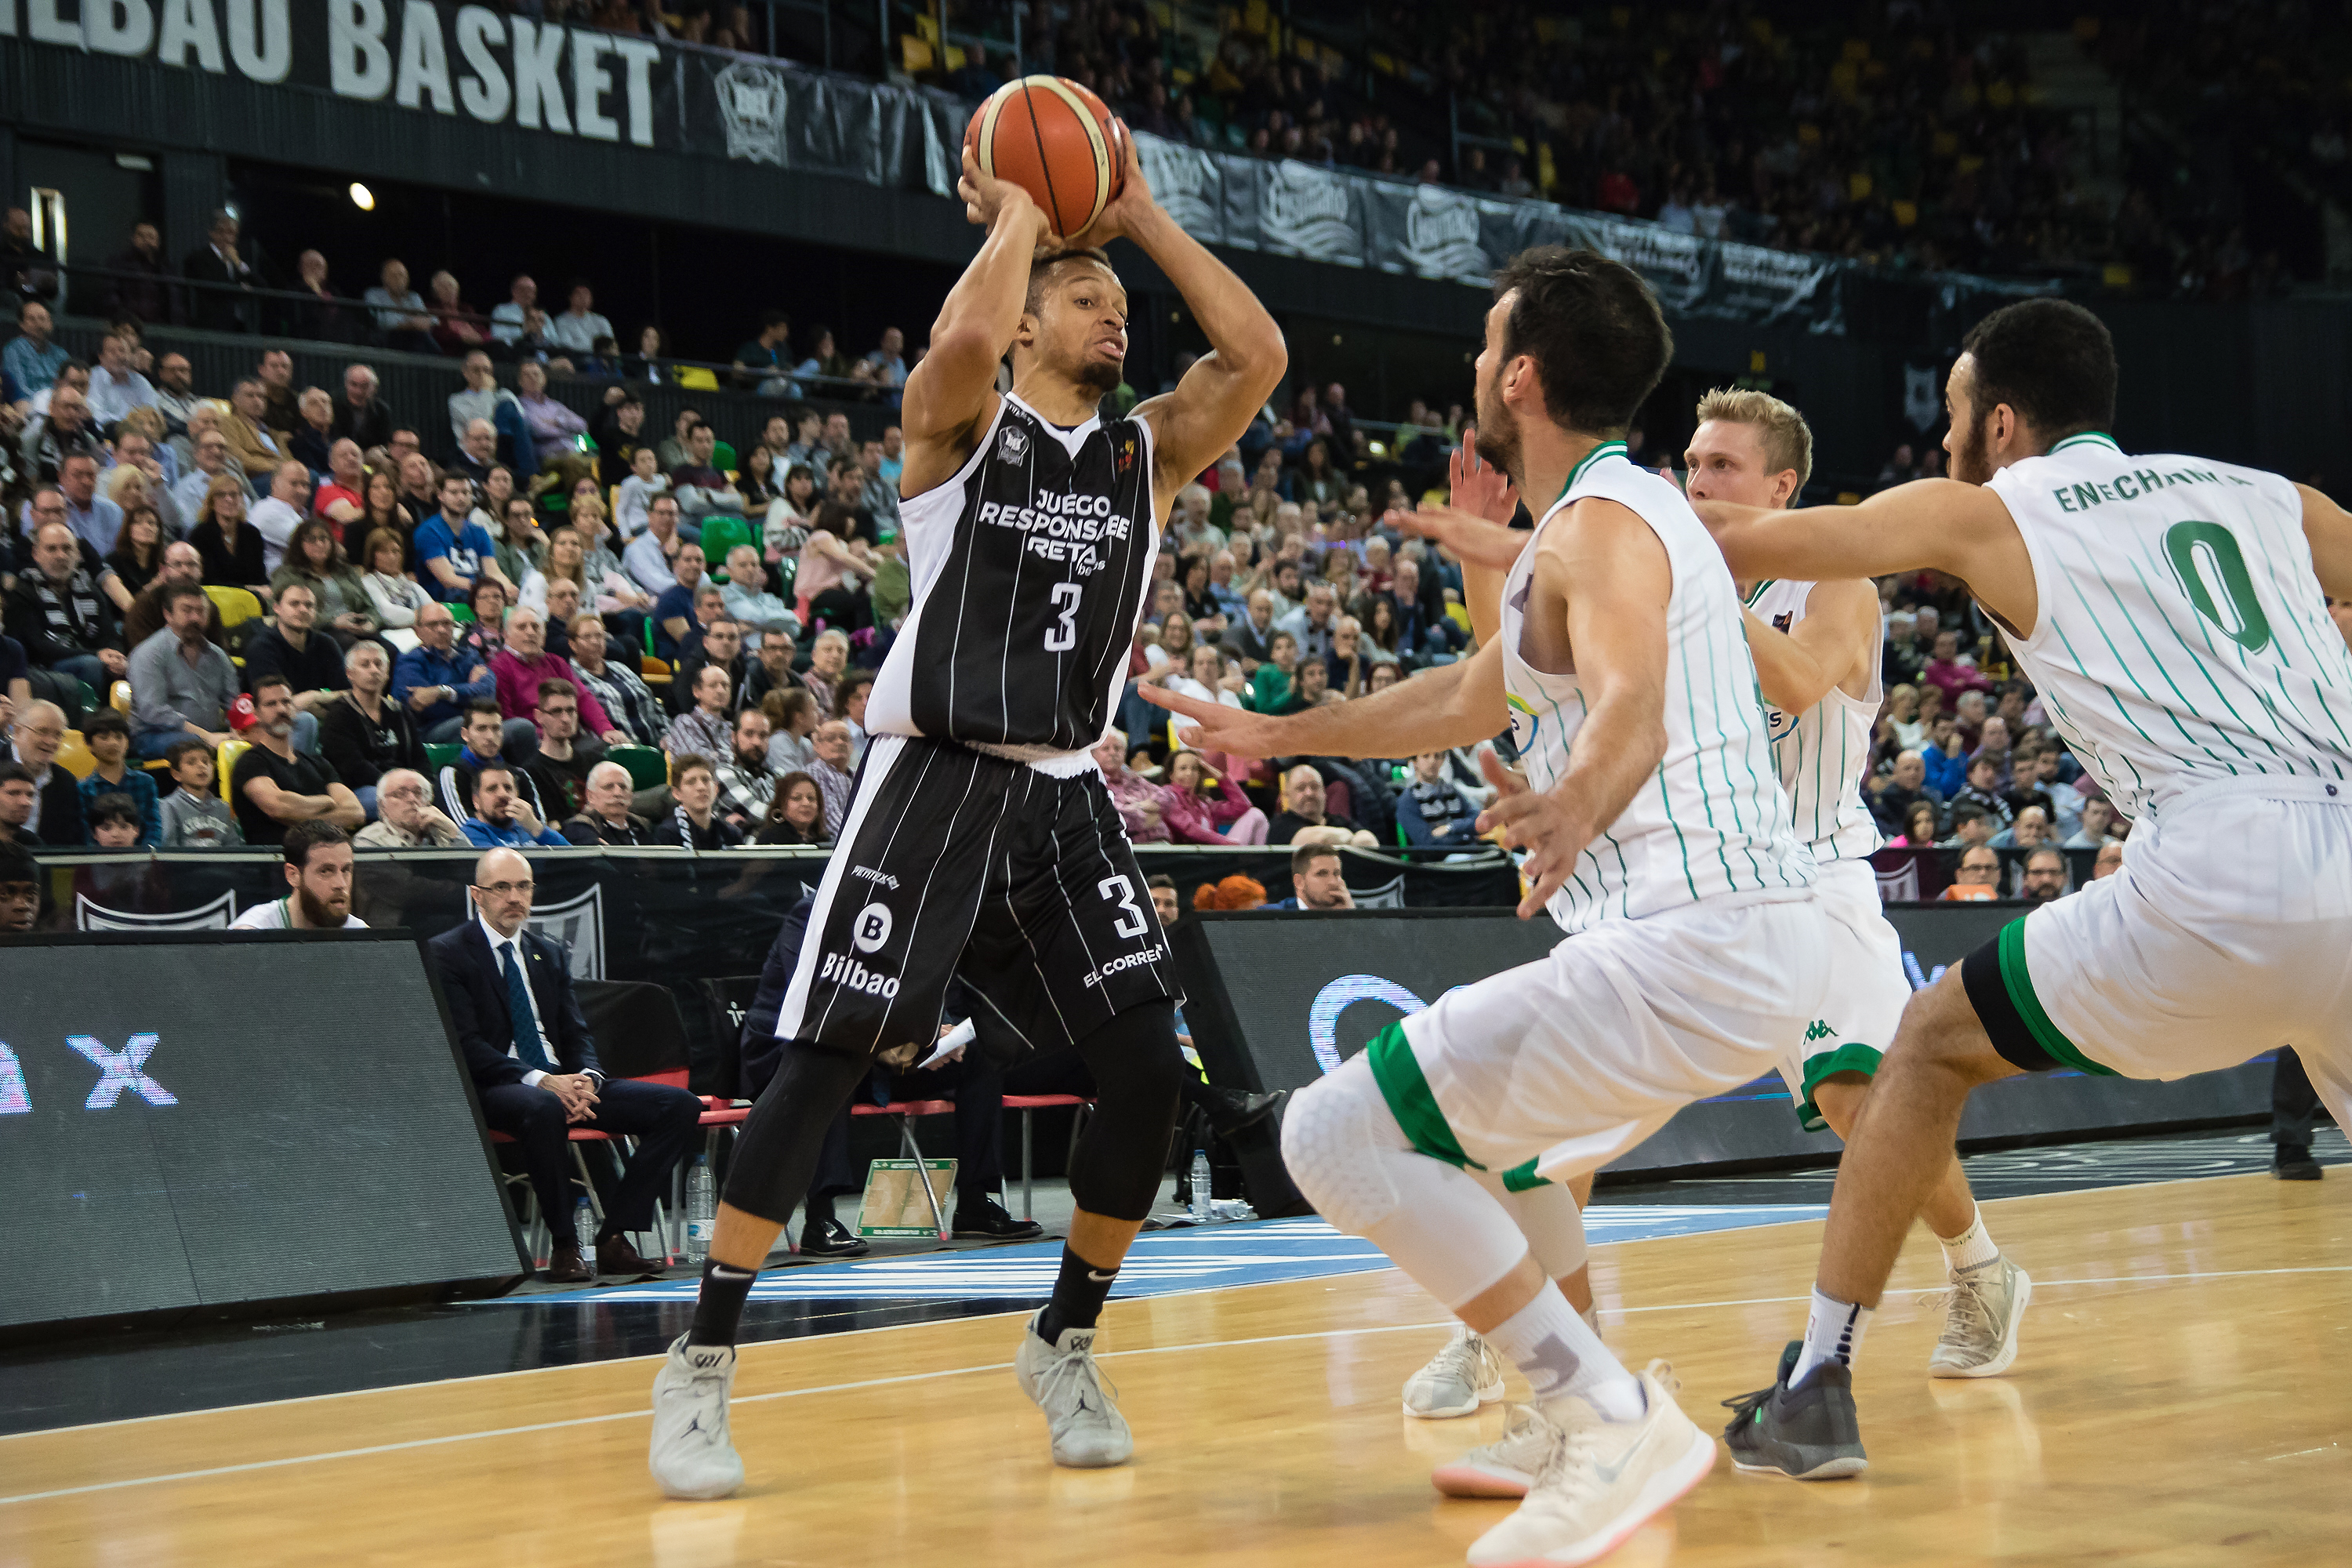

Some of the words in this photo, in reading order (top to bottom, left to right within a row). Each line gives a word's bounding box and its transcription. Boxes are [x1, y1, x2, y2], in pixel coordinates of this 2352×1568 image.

[328, 0, 660, 147] BASKET
[1036, 488, 1110, 518] JUEGO
[2161, 520, 2270, 655] 0
[1044, 582, 1083, 652] 3
[861, 913, 884, 941] B
[1098, 874, 1149, 939] 3
[820, 952, 901, 999] Bilbao
[1083, 971, 1103, 989] EL
